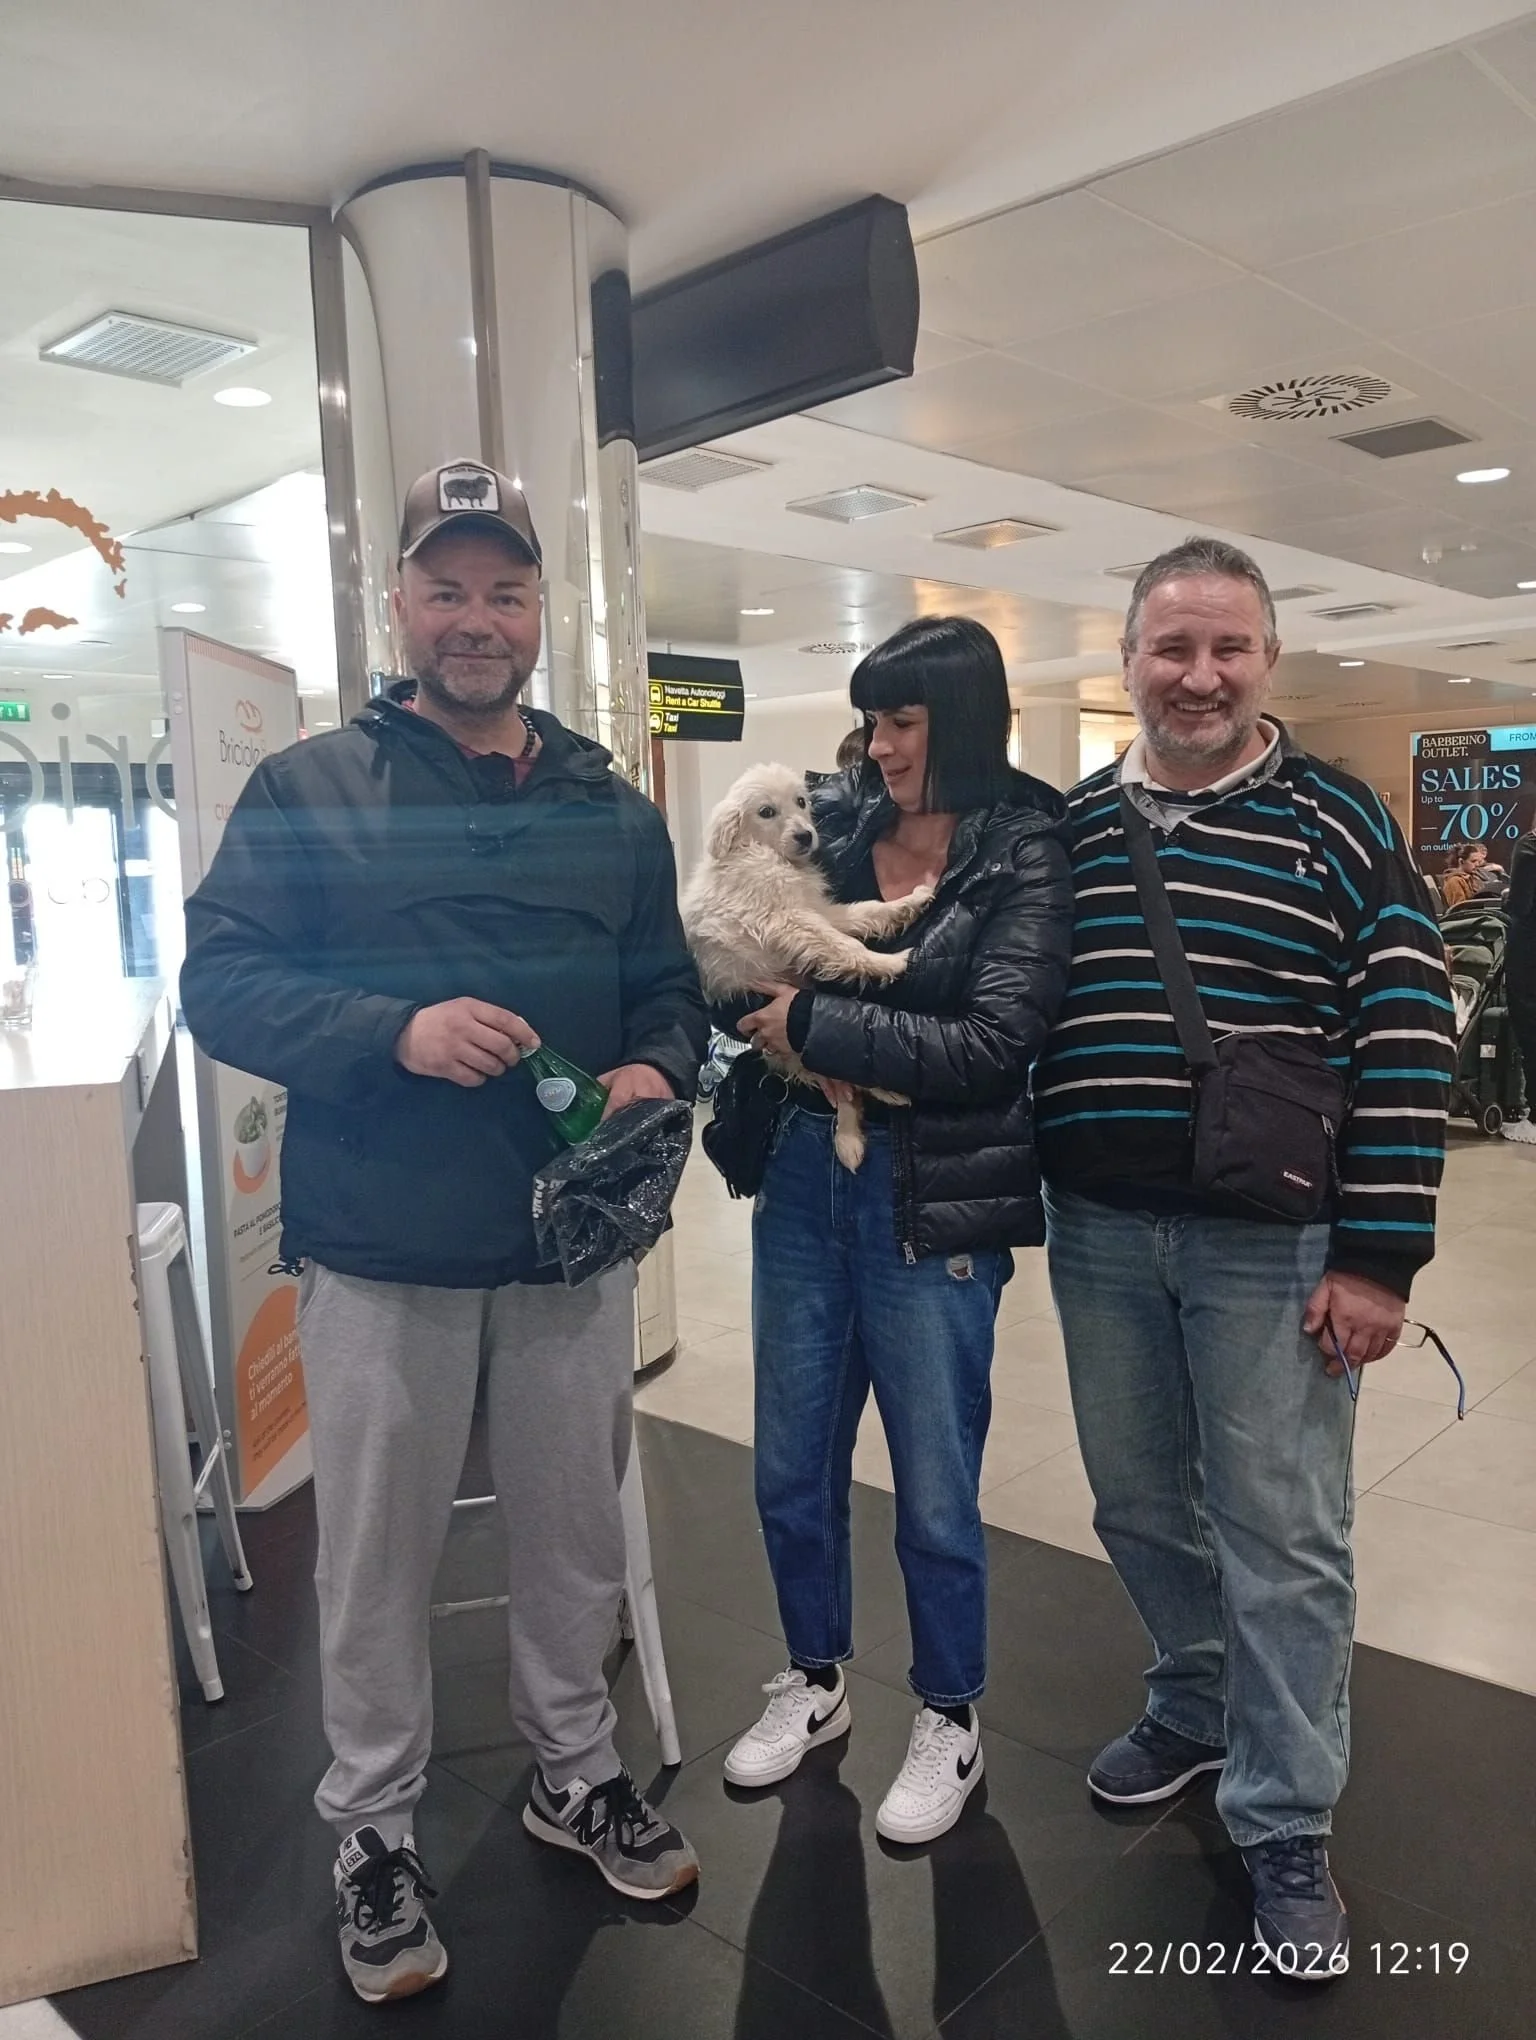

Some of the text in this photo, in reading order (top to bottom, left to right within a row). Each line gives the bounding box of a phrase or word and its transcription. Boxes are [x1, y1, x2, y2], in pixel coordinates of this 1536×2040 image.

[665, 696, 681, 705] Rent
[687, 698, 699, 707] Car
[700, 699, 722, 709] Shuttle
[665, 712, 679, 722] Taxi
[664, 723, 678, 733] Taxi
[1422, 734, 1486, 748] BARBERINO
[1509, 731, 1536, 742] FROM
[1422, 746, 1469, 758] OUTLET.
[1421, 764, 1521, 793] SALES
[1421, 795, 1443, 805] Up to
[234, 1223, 249, 1237] PASTA
[276, 1337, 283, 1355] al
[256, 1357, 288, 1392] verranno
[250, 1372, 293, 1421] al momento
